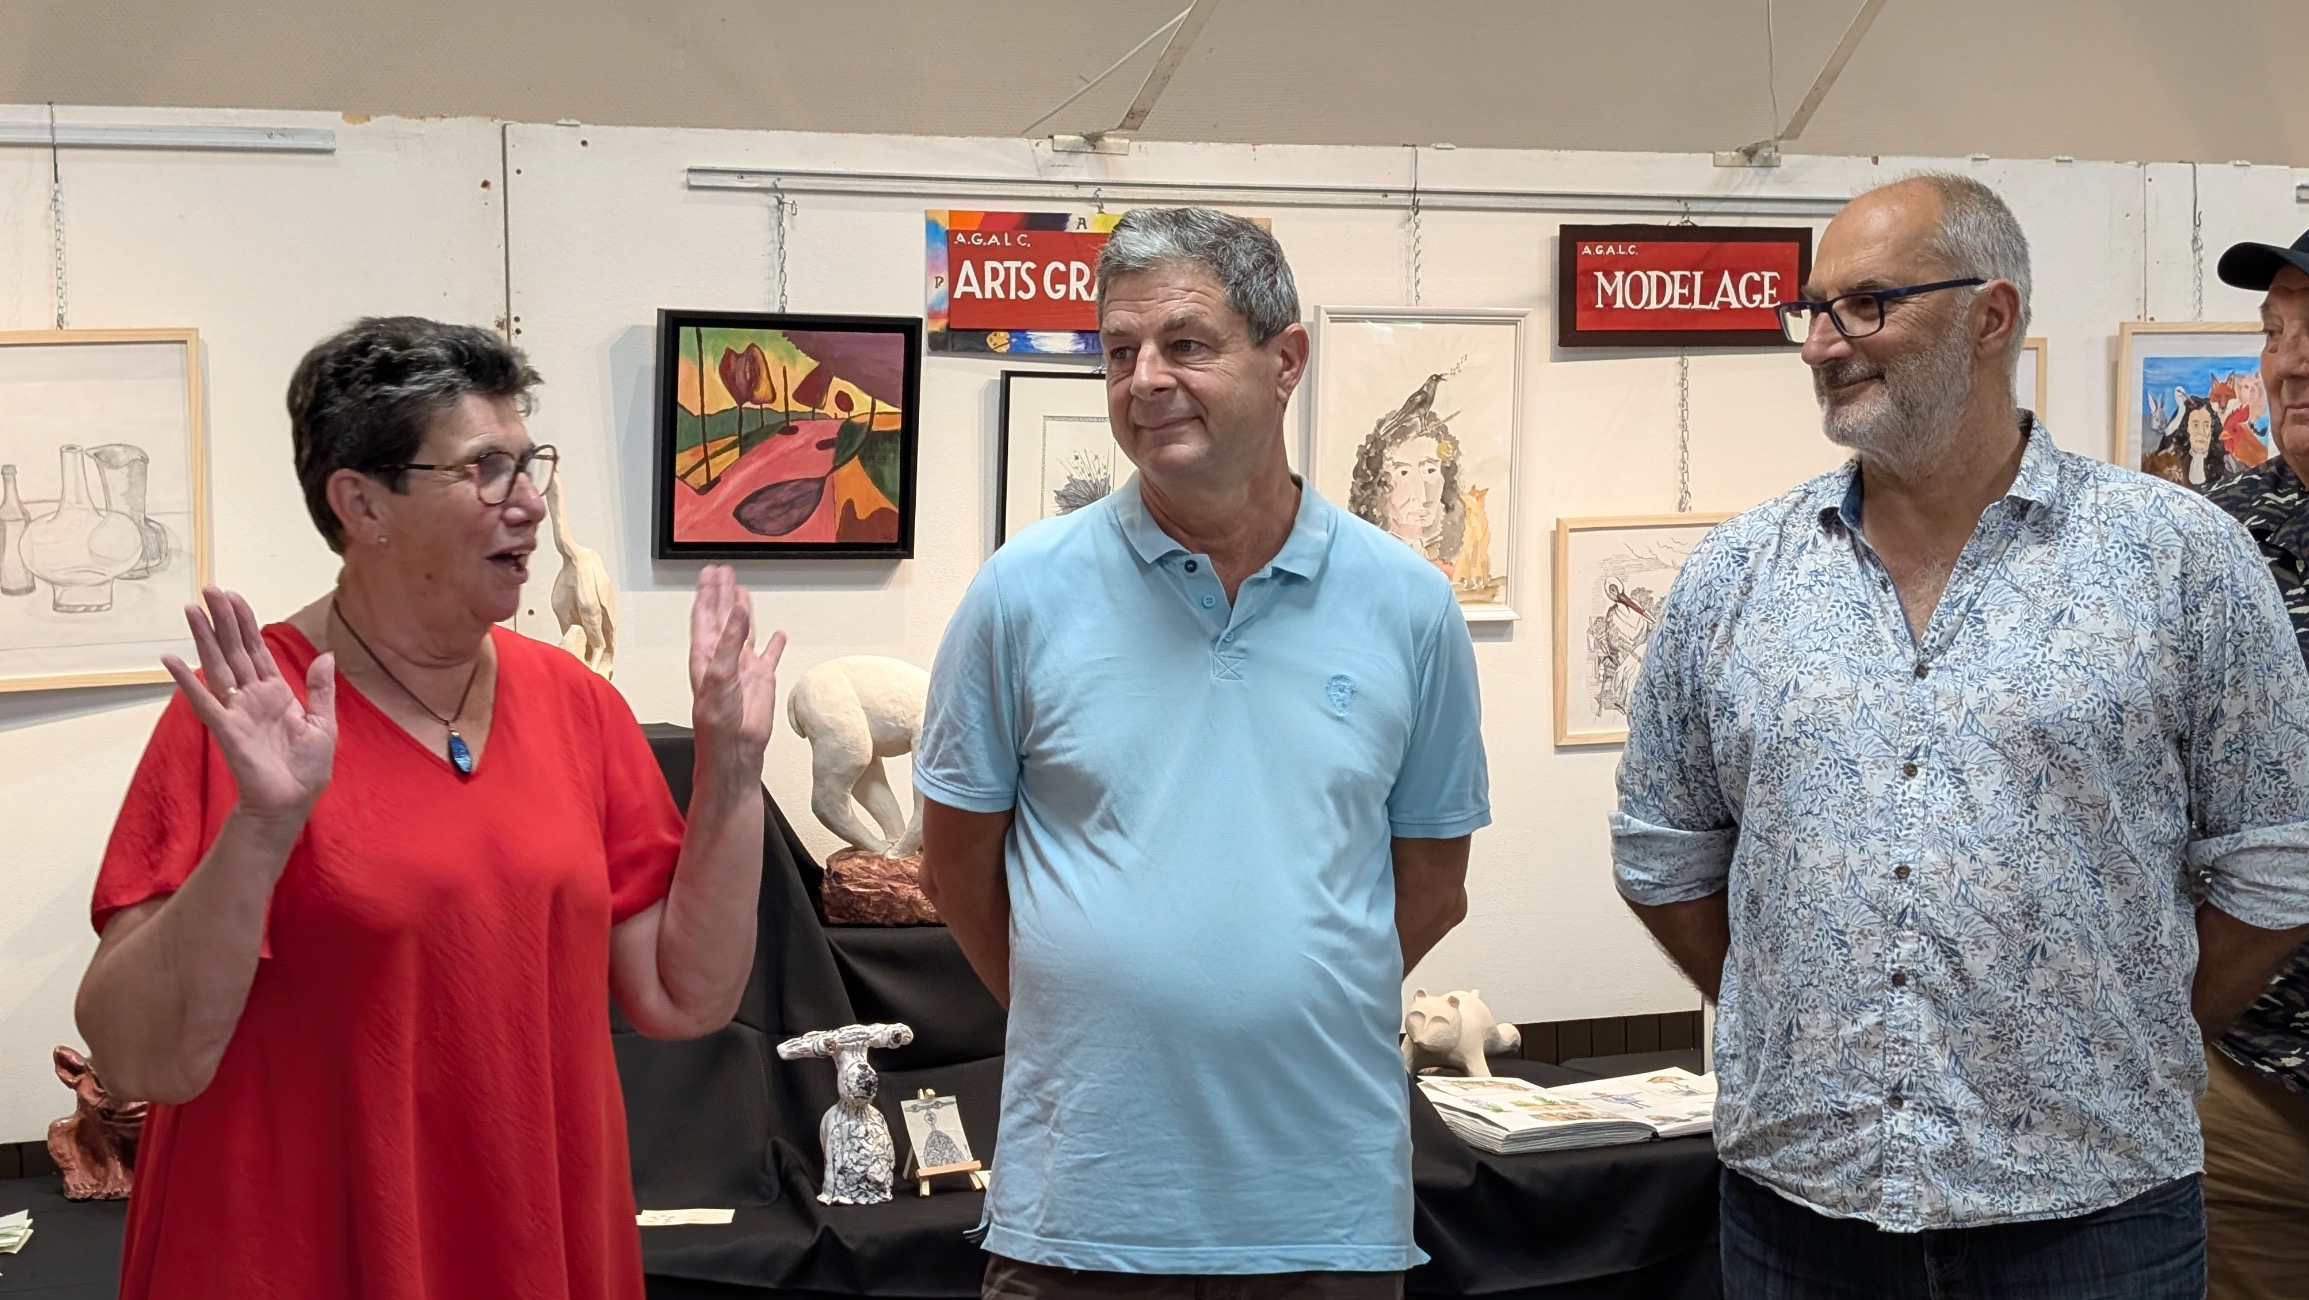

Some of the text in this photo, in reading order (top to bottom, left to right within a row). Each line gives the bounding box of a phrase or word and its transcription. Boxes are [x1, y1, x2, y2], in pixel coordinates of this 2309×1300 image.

[1077, 216, 1087, 230] A
[1581, 244, 1639, 256] A.G.A.L.C.
[953, 260, 1098, 301] ARTS GR
[1593, 269, 1781, 310] MODELAGE
